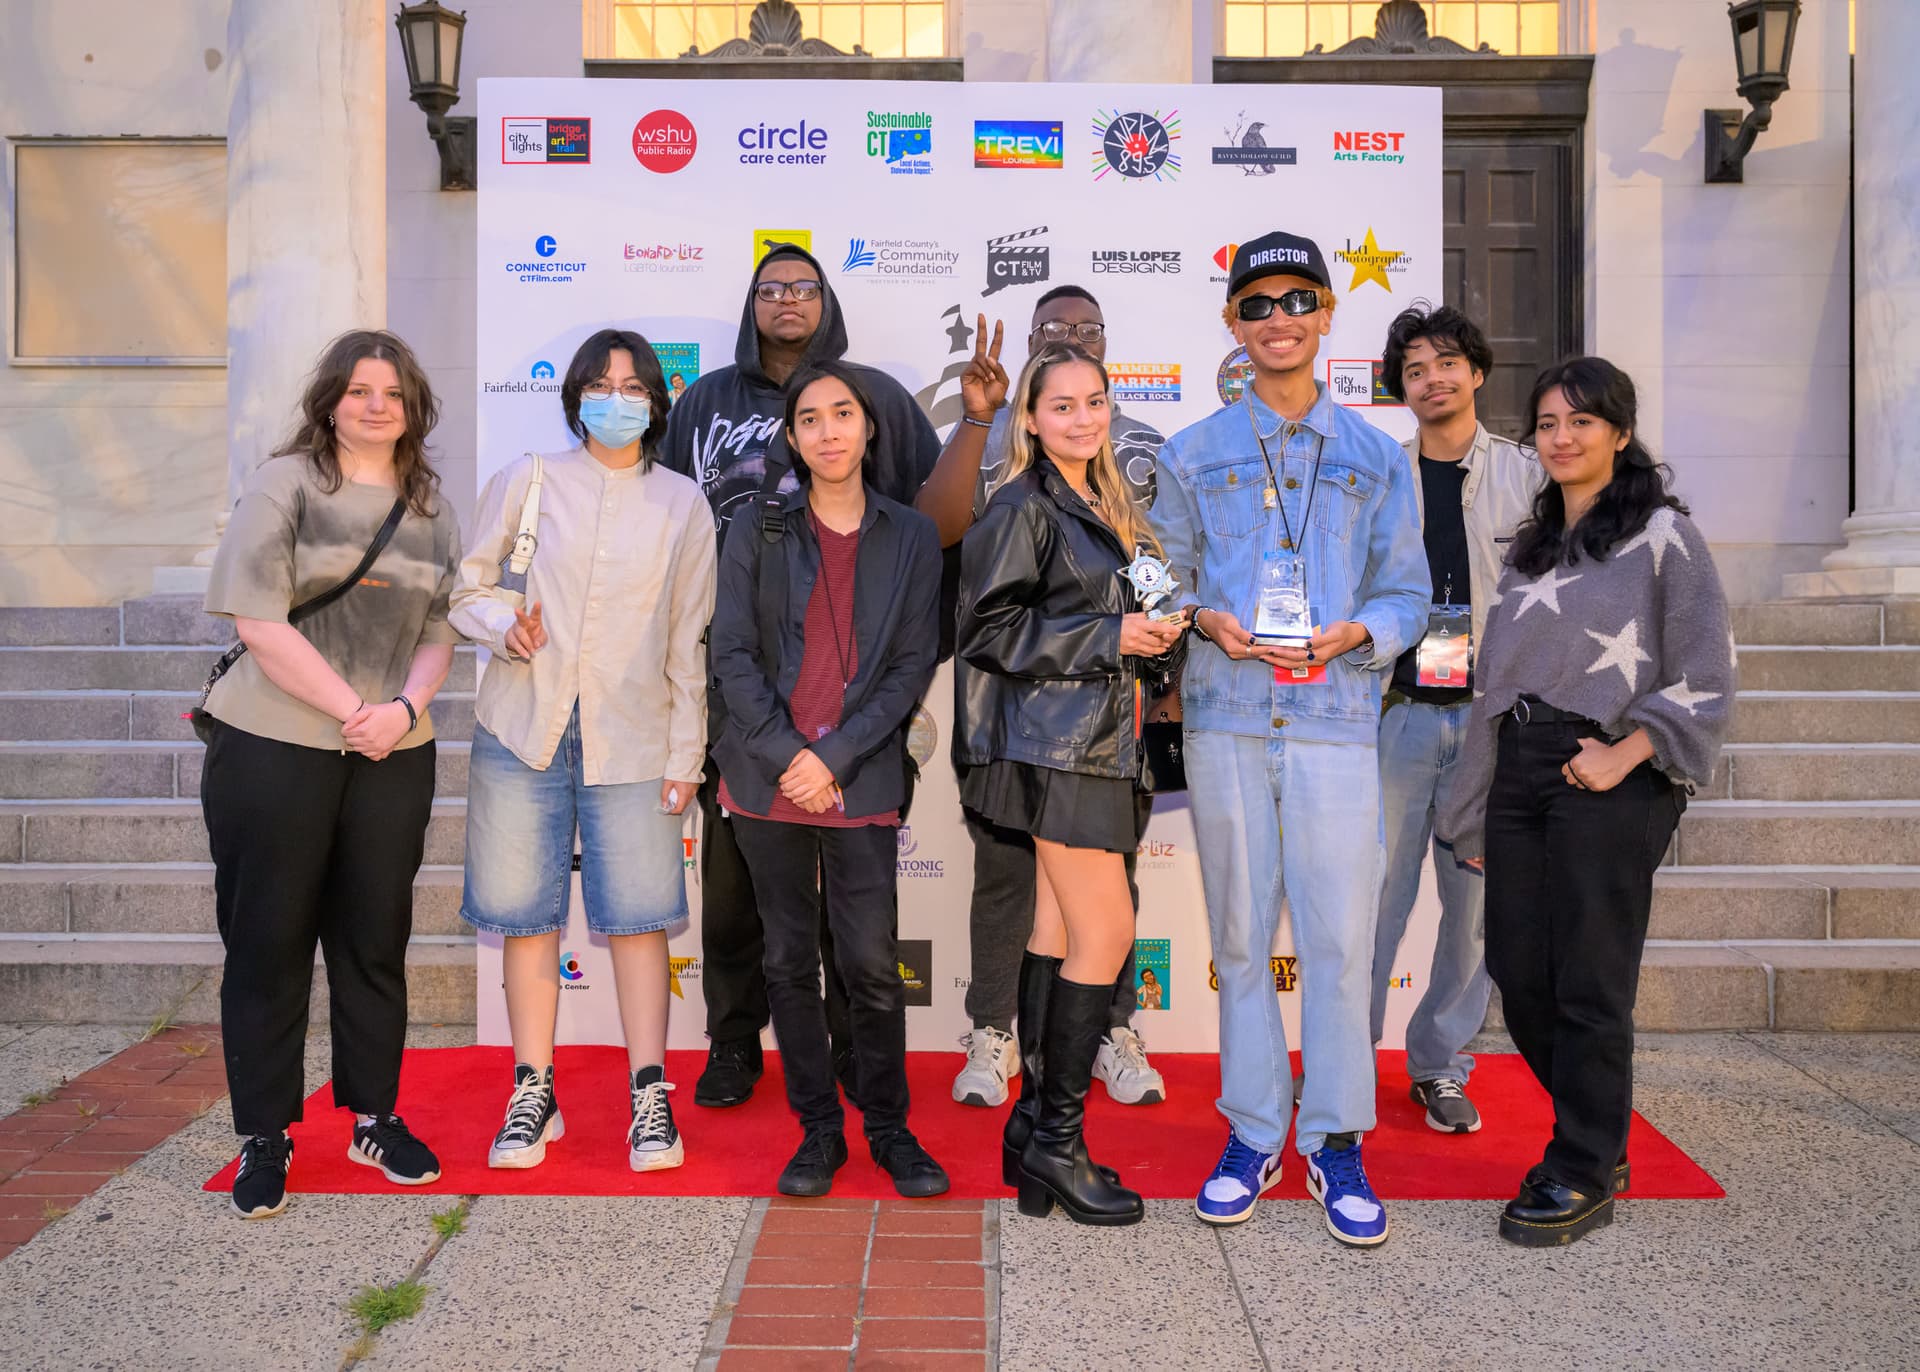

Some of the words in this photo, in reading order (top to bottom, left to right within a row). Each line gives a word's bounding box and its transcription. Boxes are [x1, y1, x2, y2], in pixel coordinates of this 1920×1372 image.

[867, 111, 932, 129] Sustainable
[549, 124, 581, 133] bridge
[637, 123, 692, 143] wshu
[738, 119, 828, 150] circle
[509, 132, 528, 143] city
[551, 136, 565, 145] art
[1334, 132, 1405, 152] NEST
[512, 142, 542, 153] lights
[556, 144, 575, 152] trail
[867, 131, 888, 157] CT
[978, 136, 1059, 154] TREVI
[637, 146, 665, 155] Public
[667, 146, 692, 155] Radio
[740, 153, 774, 164] care
[777, 152, 827, 164] center
[1118, 150, 1157, 174] 89.5
[1334, 152, 1358, 161] Arts
[1361, 152, 1404, 164] Factory
[871, 239, 902, 248] Fairfield
[904, 239, 939, 250] County's
[1346, 238, 1368, 255] La
[880, 249, 959, 264] Community
[1092, 251, 1129, 261] LUIS
[1130, 251, 1181, 262] LOPEZ
[1250, 248, 1309, 268] DIRECTOR
[1334, 251, 1412, 267] Photographie
[506, 263, 587, 272] CONNECTICUT
[624, 263, 657, 273] LGBTQ
[660, 263, 704, 273] foundation
[877, 262, 952, 274] Foundation
[994, 261, 1020, 276] CT
[1021, 268, 1042, 276] &TV
[1092, 262, 1181, 274] DESIGNS
[520, 274, 573, 283] CTFilm.com
[1334, 375, 1354, 385] city
[484, 381, 527, 393] Fairfield
[1338, 383, 1368, 396] lights
